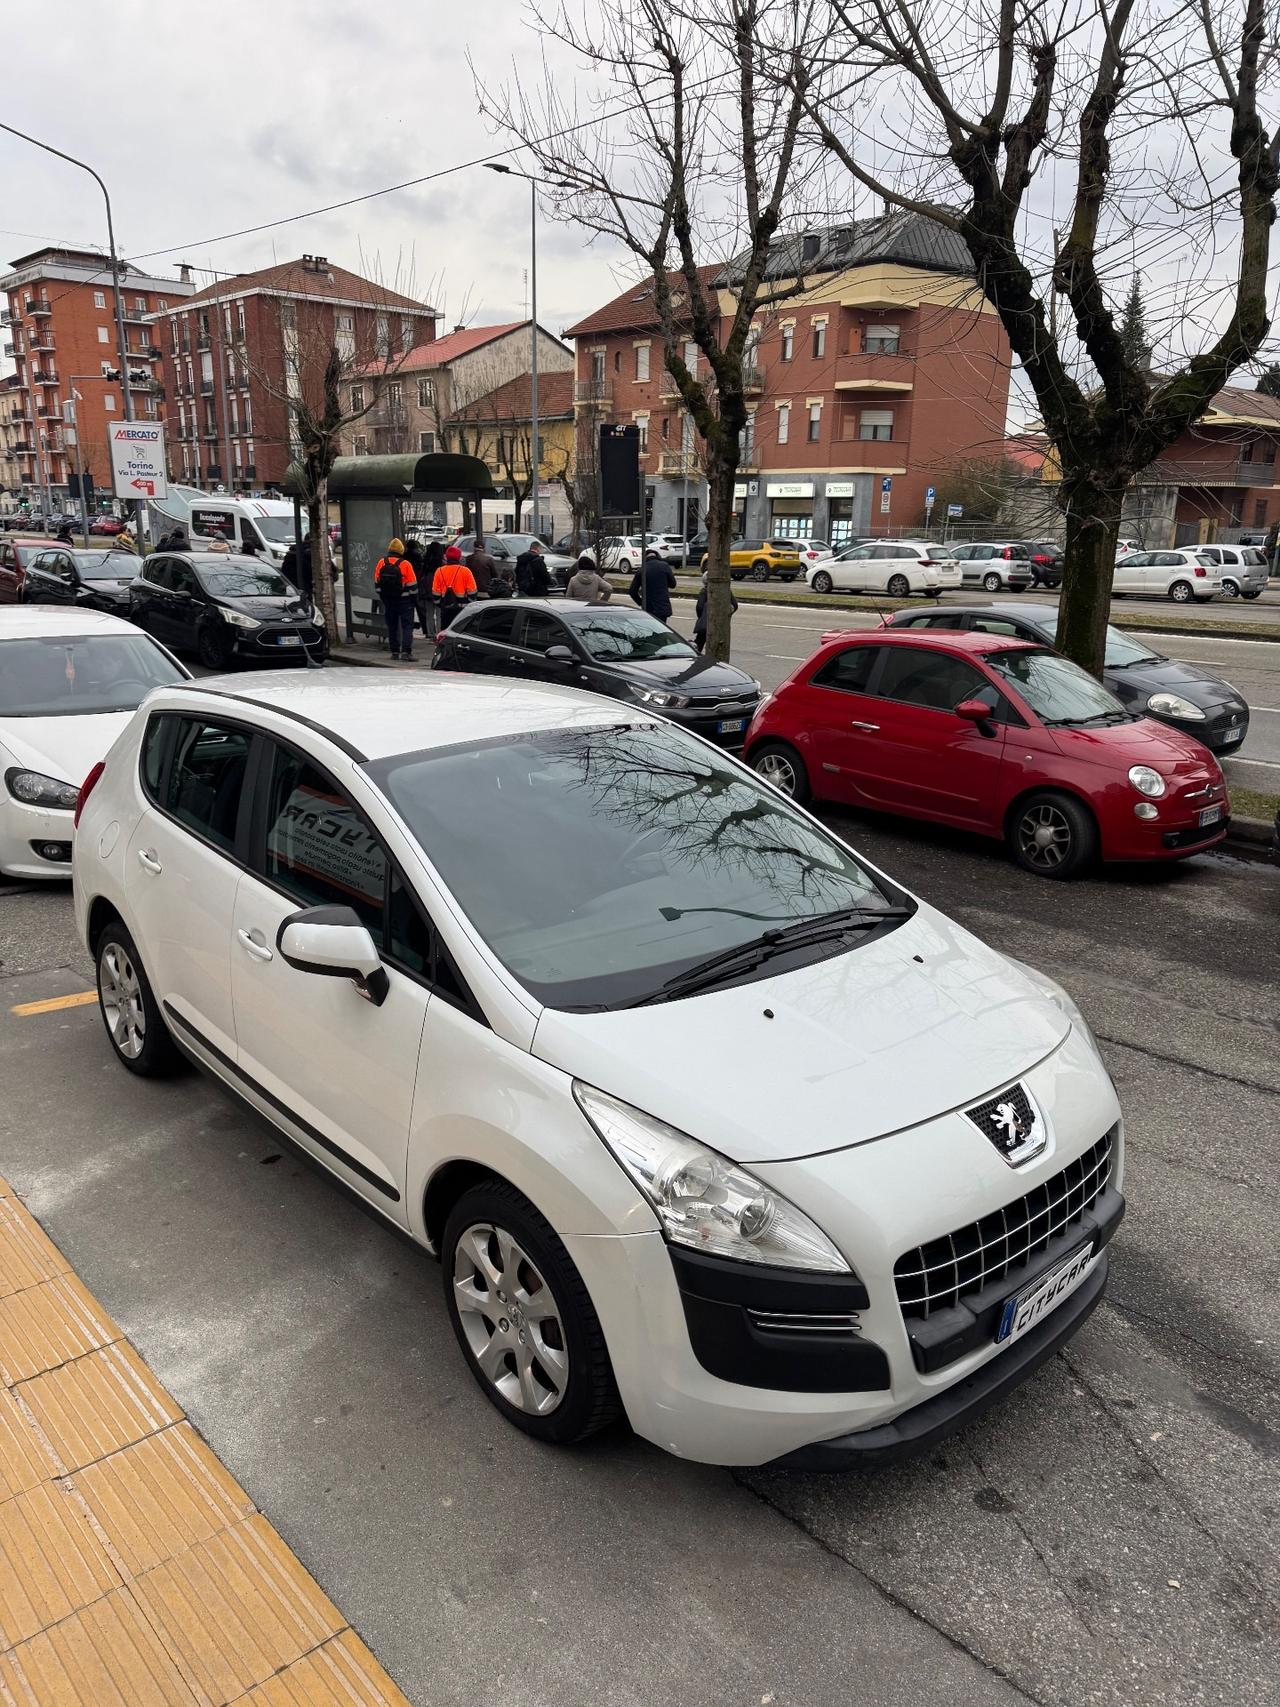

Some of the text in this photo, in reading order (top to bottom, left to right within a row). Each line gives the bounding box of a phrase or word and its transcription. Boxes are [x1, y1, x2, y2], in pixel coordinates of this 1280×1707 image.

[127, 461, 154, 470] Torino
[928, 488, 934, 497] P
[1017, 1253, 1091, 1331] CITYCAR
